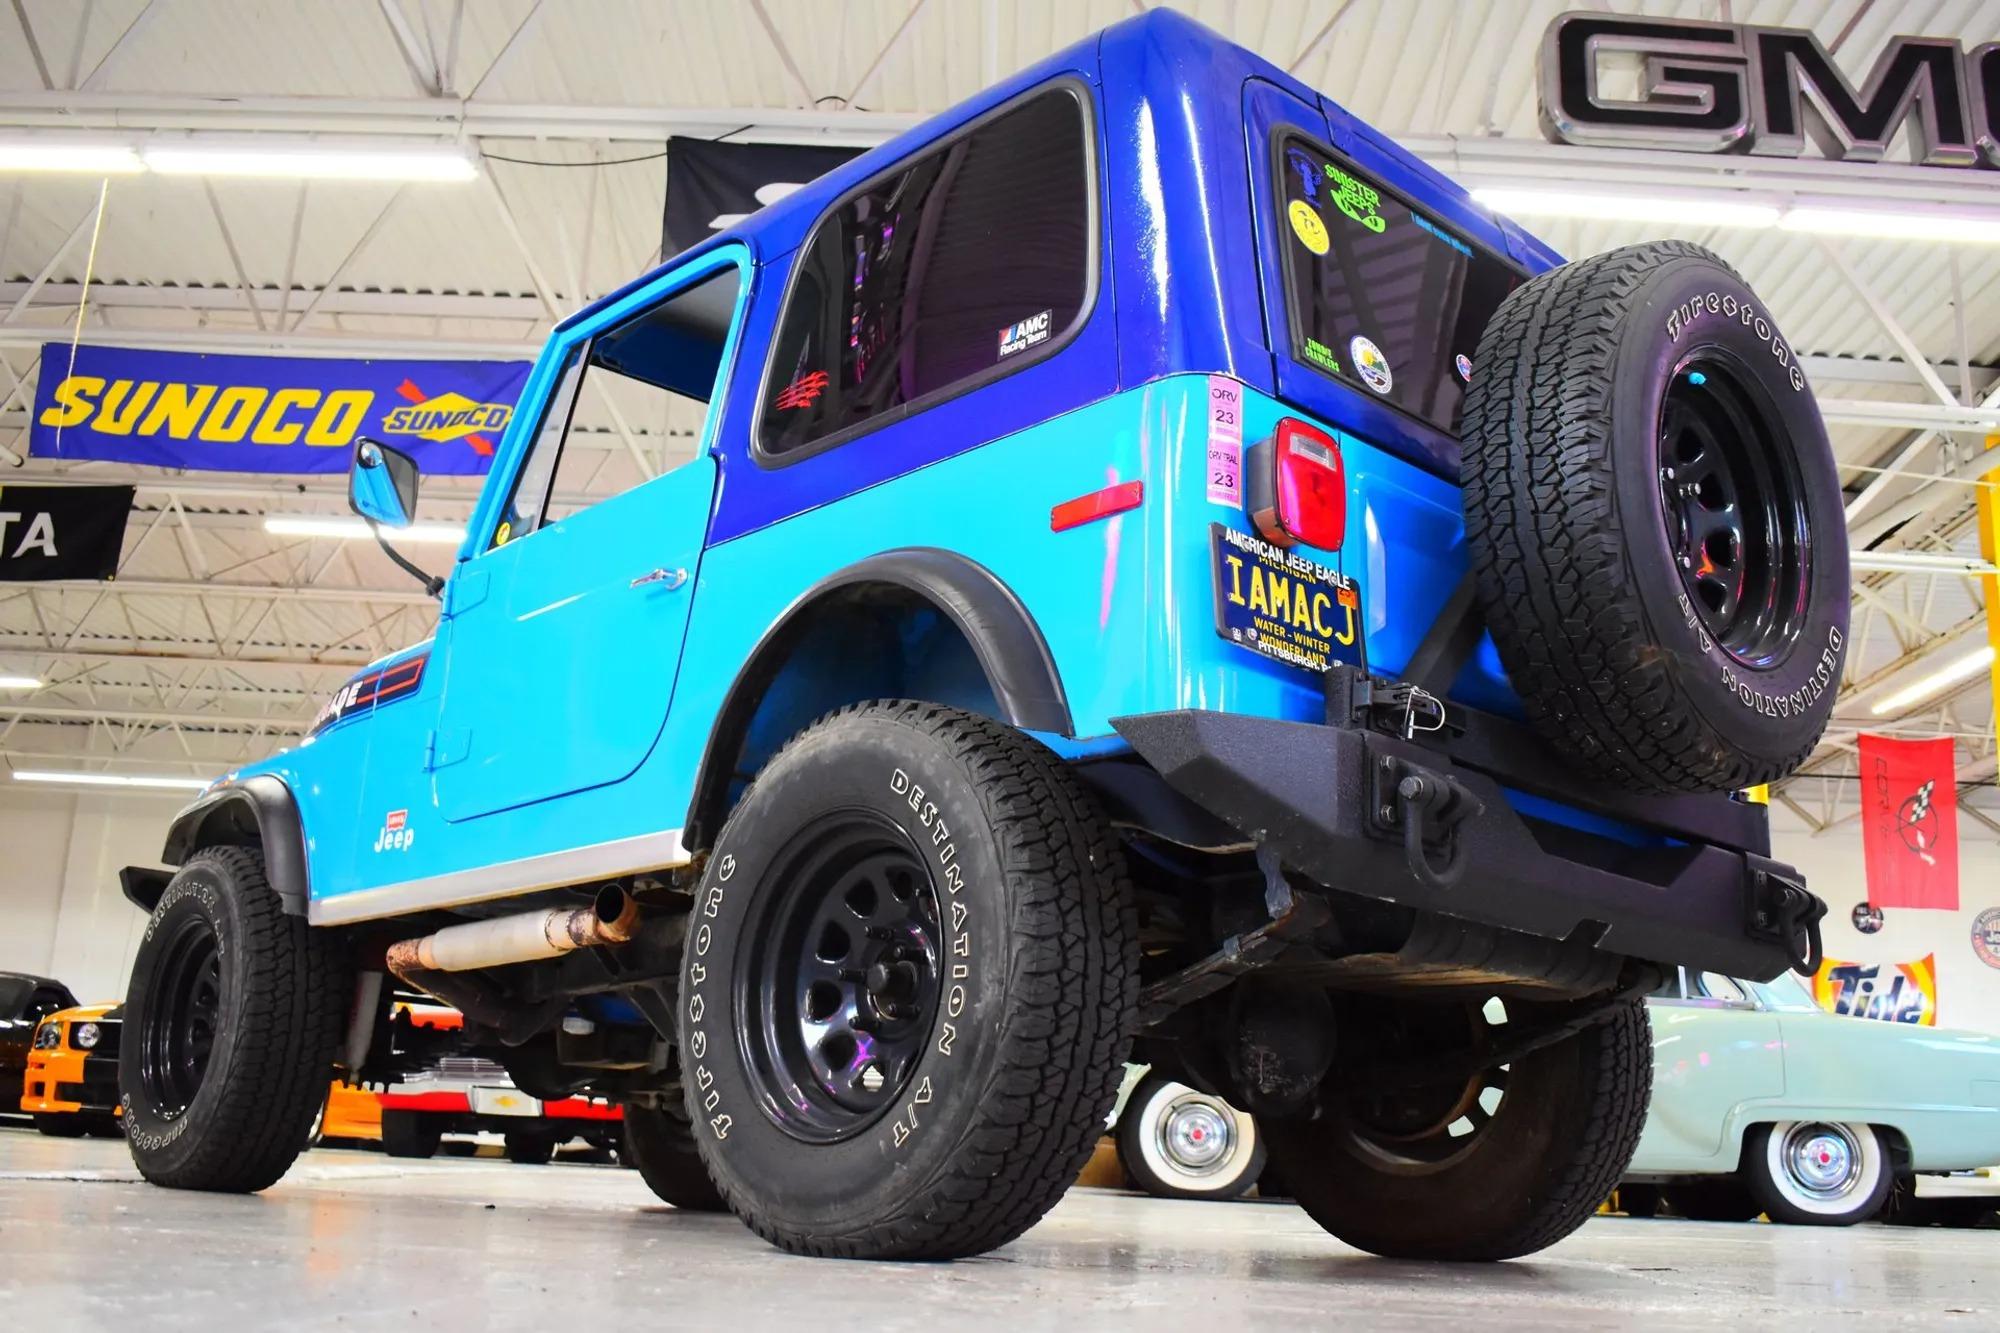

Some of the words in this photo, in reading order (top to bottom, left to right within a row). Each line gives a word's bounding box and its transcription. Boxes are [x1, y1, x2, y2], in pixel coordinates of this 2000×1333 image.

[1537, 10, 2000, 168] GM
[1000, 338, 1026, 356] Racing
[1026, 330, 1047, 344] Team
[1016, 313, 1048, 340] AMC
[1666, 292, 1805, 392] Firestone
[40, 376, 375, 447] SUNOCO
[389, 404, 508, 432] SUNOCO
[1212, 388, 1237, 402] ORV
[1215, 409, 1234, 425] 23
[1214, 472, 1234, 488] 23
[1225, 527, 1283, 563] AMERICAN
[1286, 552, 1313, 574] JEEP
[1315, 564, 1351, 591] EAGLE
[1226, 554, 1356, 646] IAMACJ
[1678, 593, 1712, 655] A/T
[1254, 616, 1285, 638] WATER
[1293, 631, 1330, 654] WINTER
[1260, 632, 1326, 665] WONDERLAND
[1721, 626, 1842, 718] DESTINATION
[374, 827, 414, 853] Jeep
[146, 882, 215, 942] DESTINATION
[890, 769, 969, 1056] DESTINATION
[689, 854, 736, 1141] Firestone
[1828, 964, 1922, 1025] Tide
[122, 1093, 188, 1150] Firestone
[894, 1077, 932, 1148] A/T
